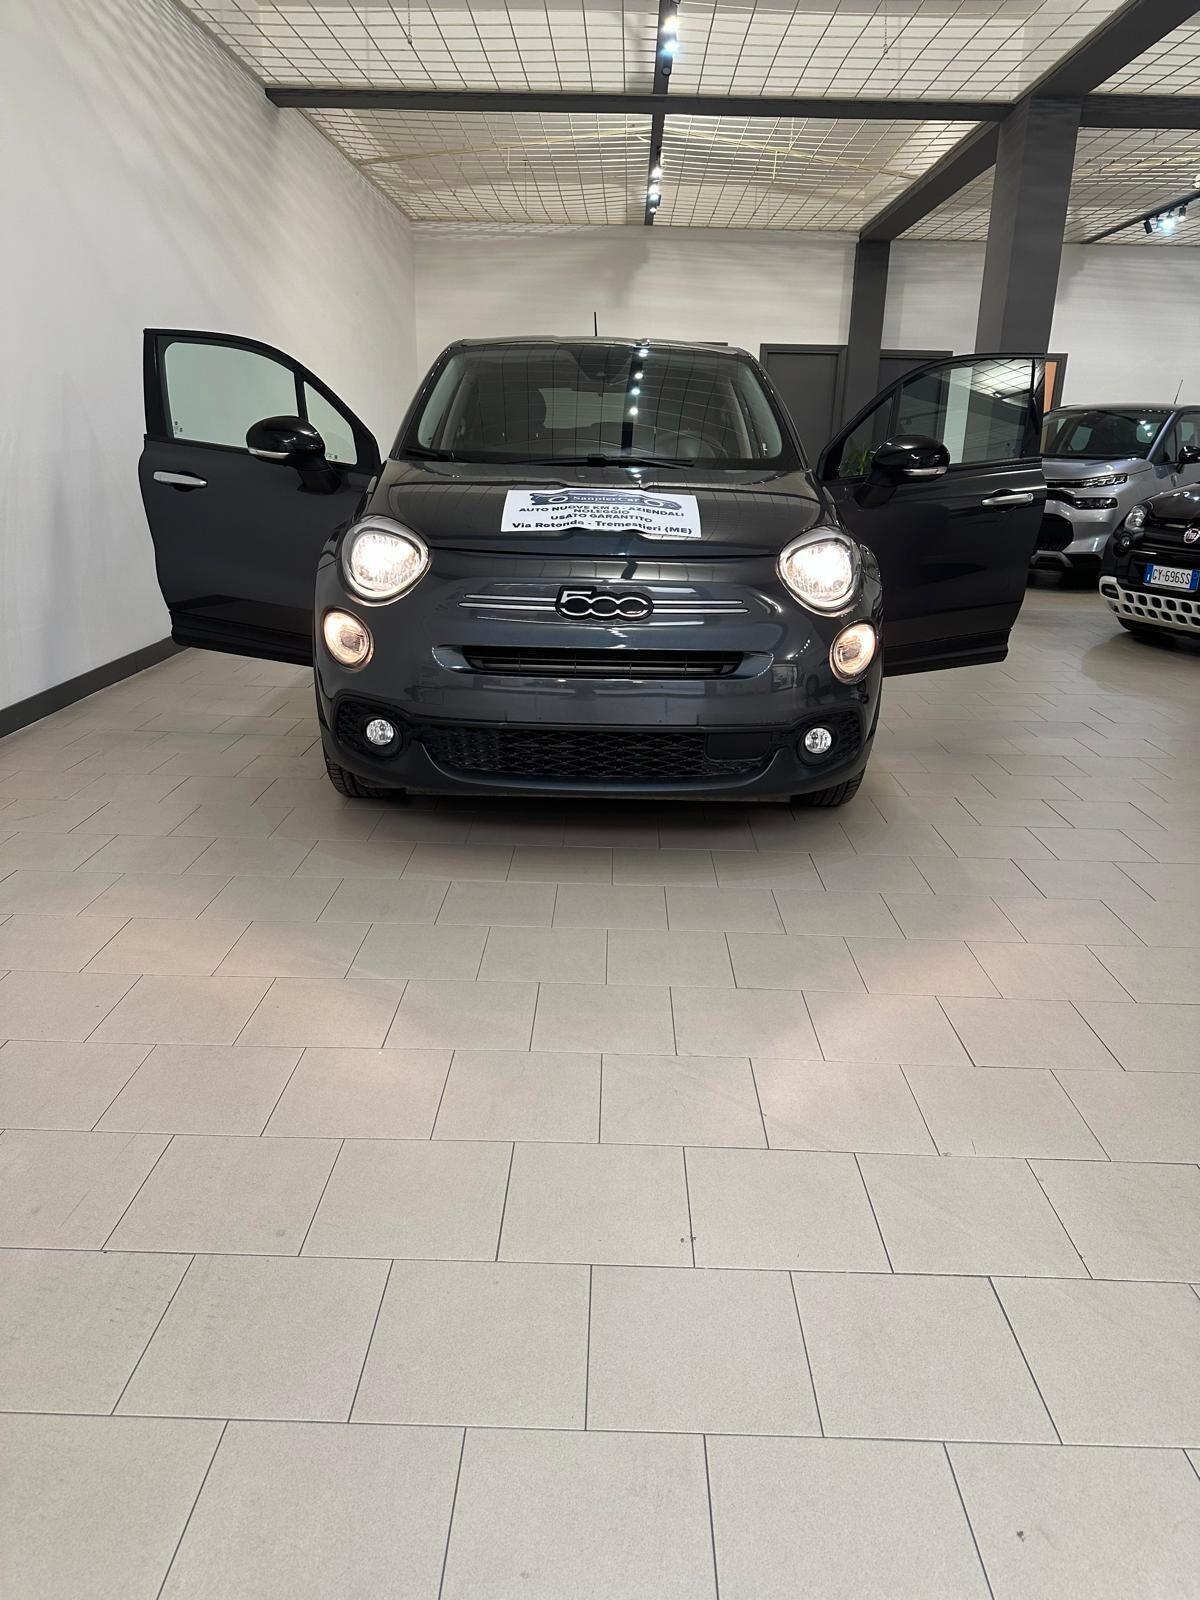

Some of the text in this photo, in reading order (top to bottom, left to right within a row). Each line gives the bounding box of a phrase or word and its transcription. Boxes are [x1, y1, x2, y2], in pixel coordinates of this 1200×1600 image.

[628, 506, 684, 516] AZIENDALI
[590, 514, 652, 522] GARANTITO
[595, 521, 661, 531] Tremestieri
[664, 526, 692, 534] (ME)
[559, 589, 650, 617] 500
